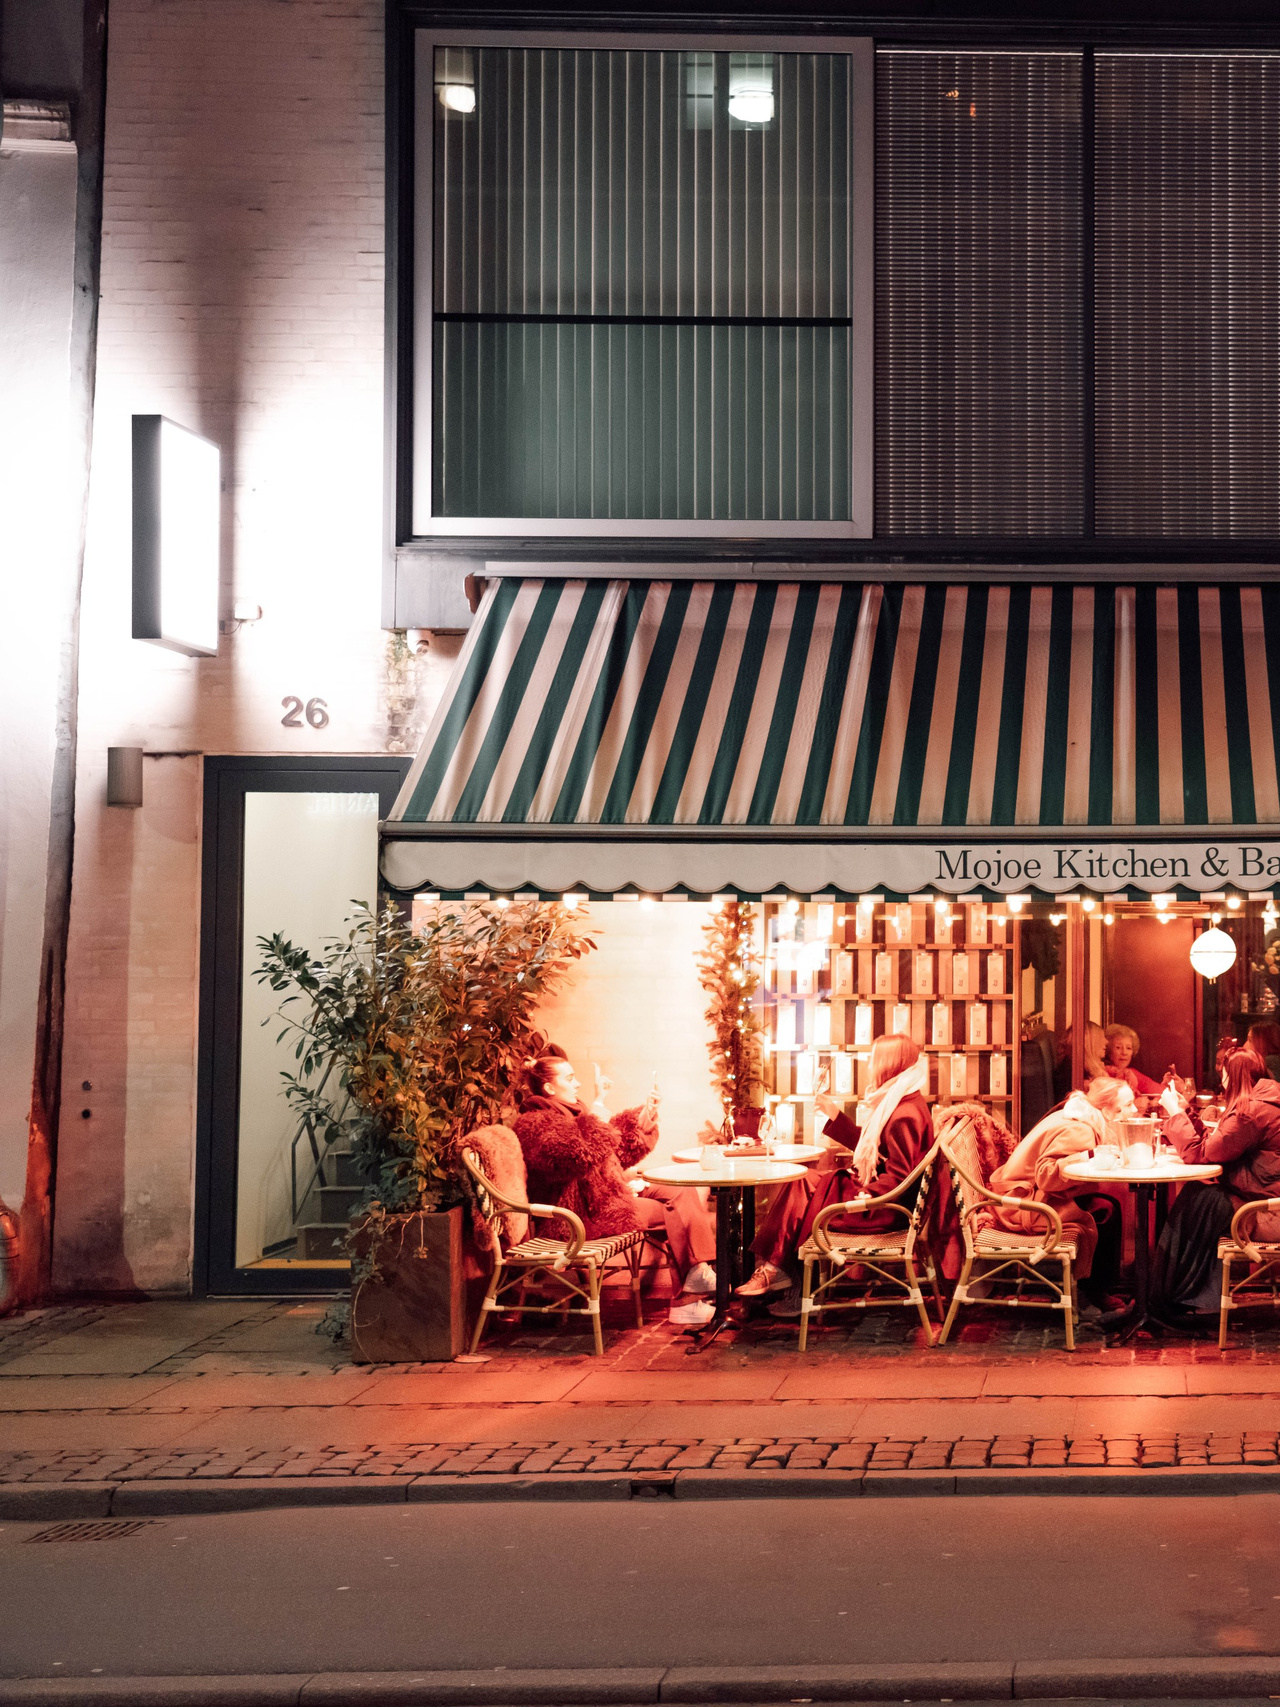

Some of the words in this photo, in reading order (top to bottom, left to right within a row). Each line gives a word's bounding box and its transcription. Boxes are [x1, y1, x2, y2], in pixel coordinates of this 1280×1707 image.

[281, 695, 330, 729] 26
[935, 850, 1041, 886] Mojoe
[1053, 849, 1191, 878] Kitchen
[1200, 847, 1230, 877] &
